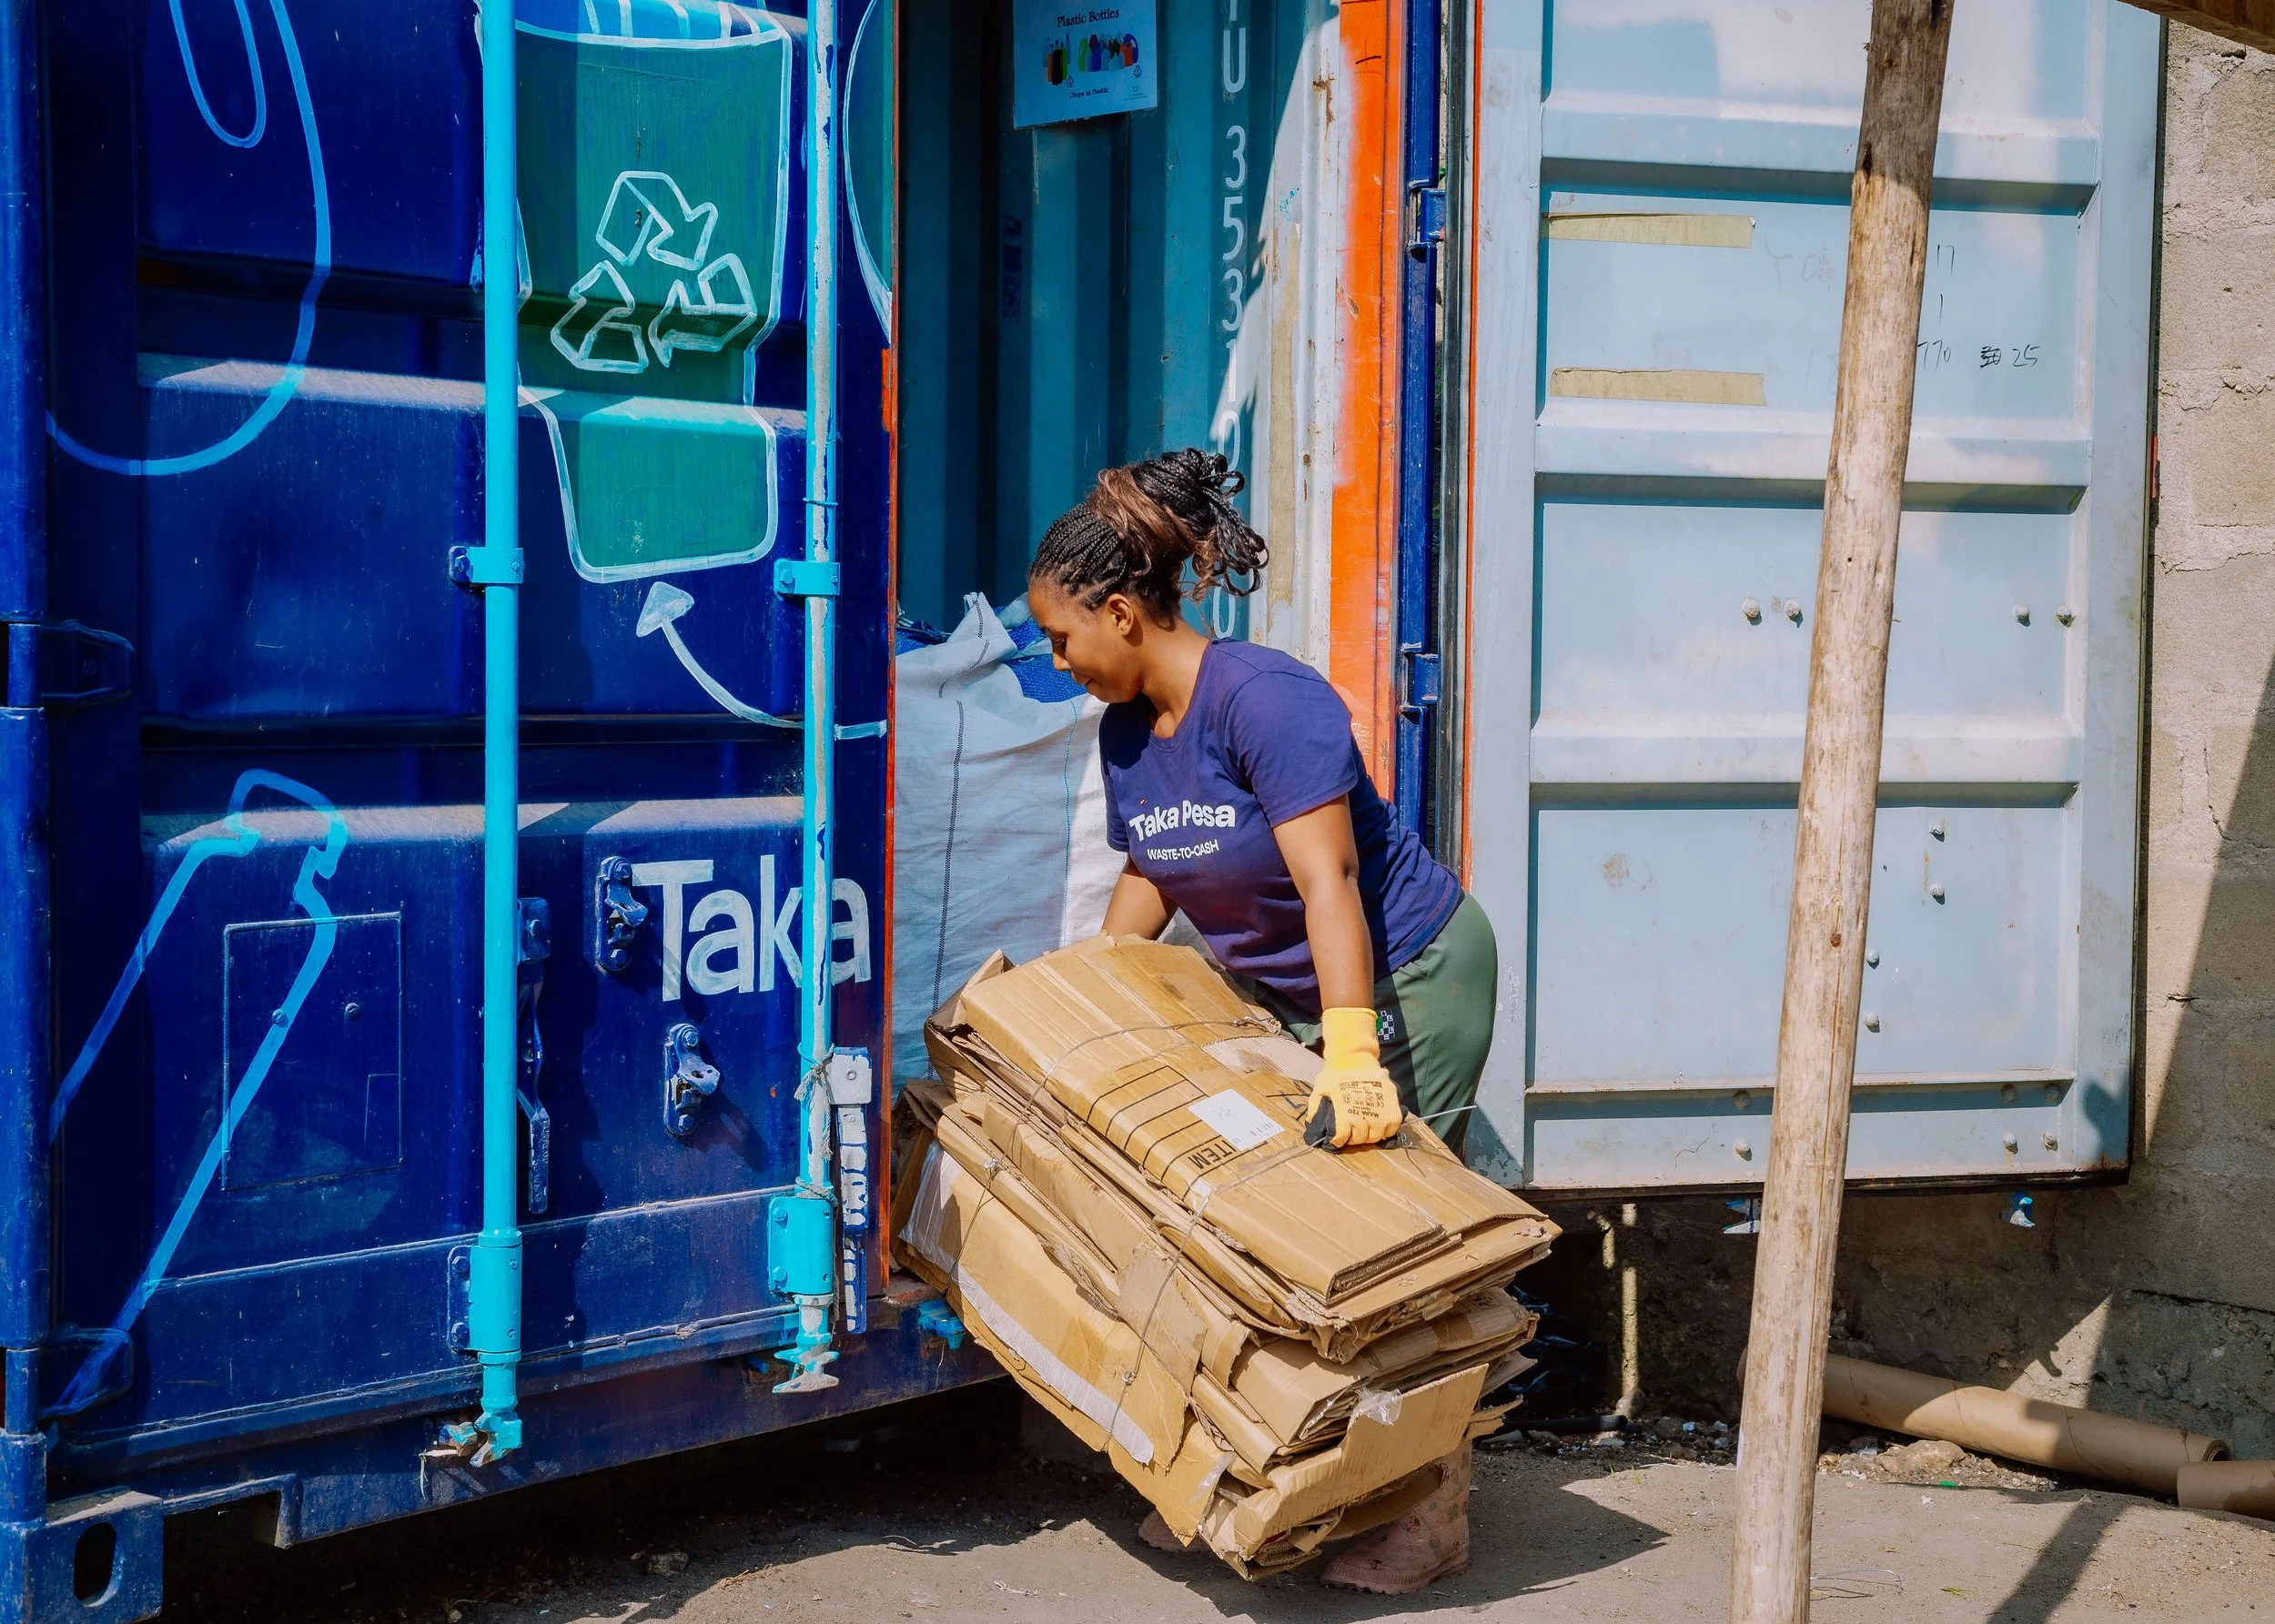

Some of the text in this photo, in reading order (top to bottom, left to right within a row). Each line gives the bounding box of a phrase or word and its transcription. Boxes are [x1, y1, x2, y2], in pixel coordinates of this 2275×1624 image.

[1057, 7, 1120, 28] Plastic Bottles
[2012, 344, 2041, 368] 25
[1128, 800, 1237, 842] Taka Pesa
[1147, 839, 1220, 861] WASTE-TO-CASH
[632, 853, 872, 1002] Taka
[1187, 1139, 1238, 1170] ITEM
